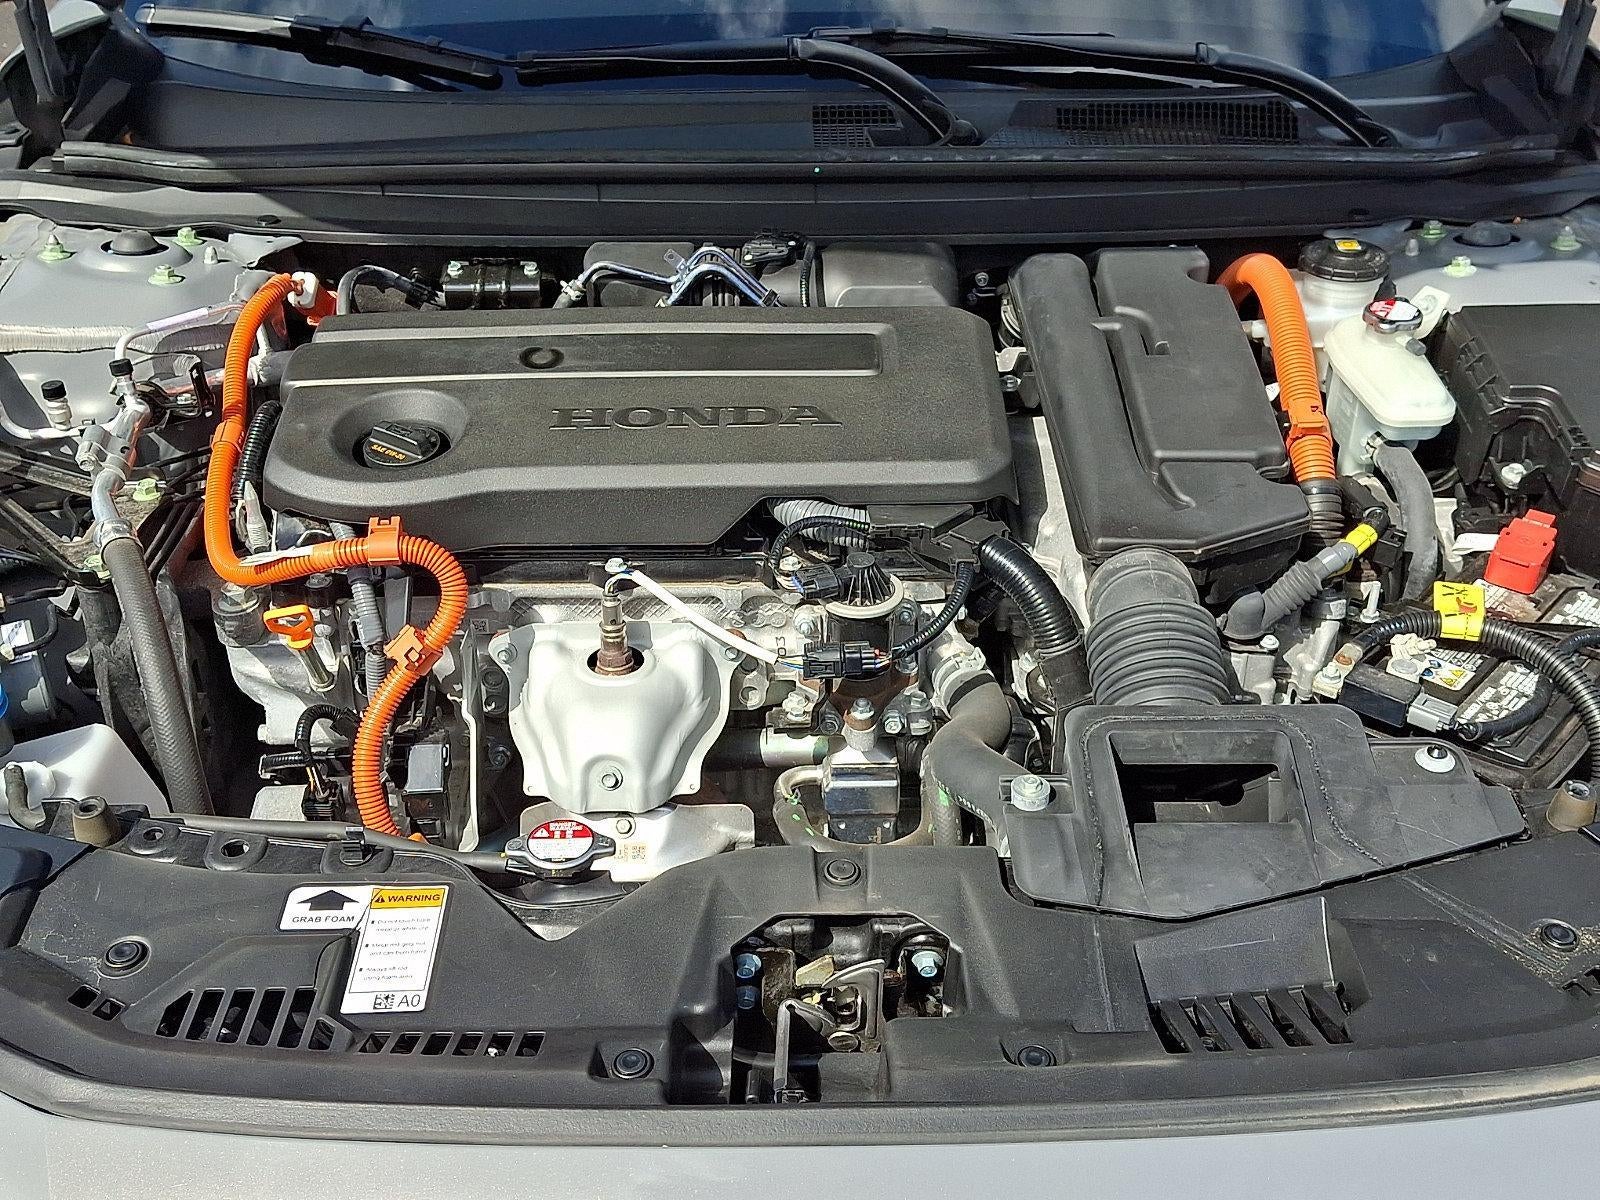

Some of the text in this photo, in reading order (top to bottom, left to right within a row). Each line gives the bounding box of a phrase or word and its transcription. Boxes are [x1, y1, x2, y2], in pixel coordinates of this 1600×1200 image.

[549, 405, 843, 430] HONDA
[387, 893, 441, 903] WARNING
[397, 994, 421, 1008] A0
